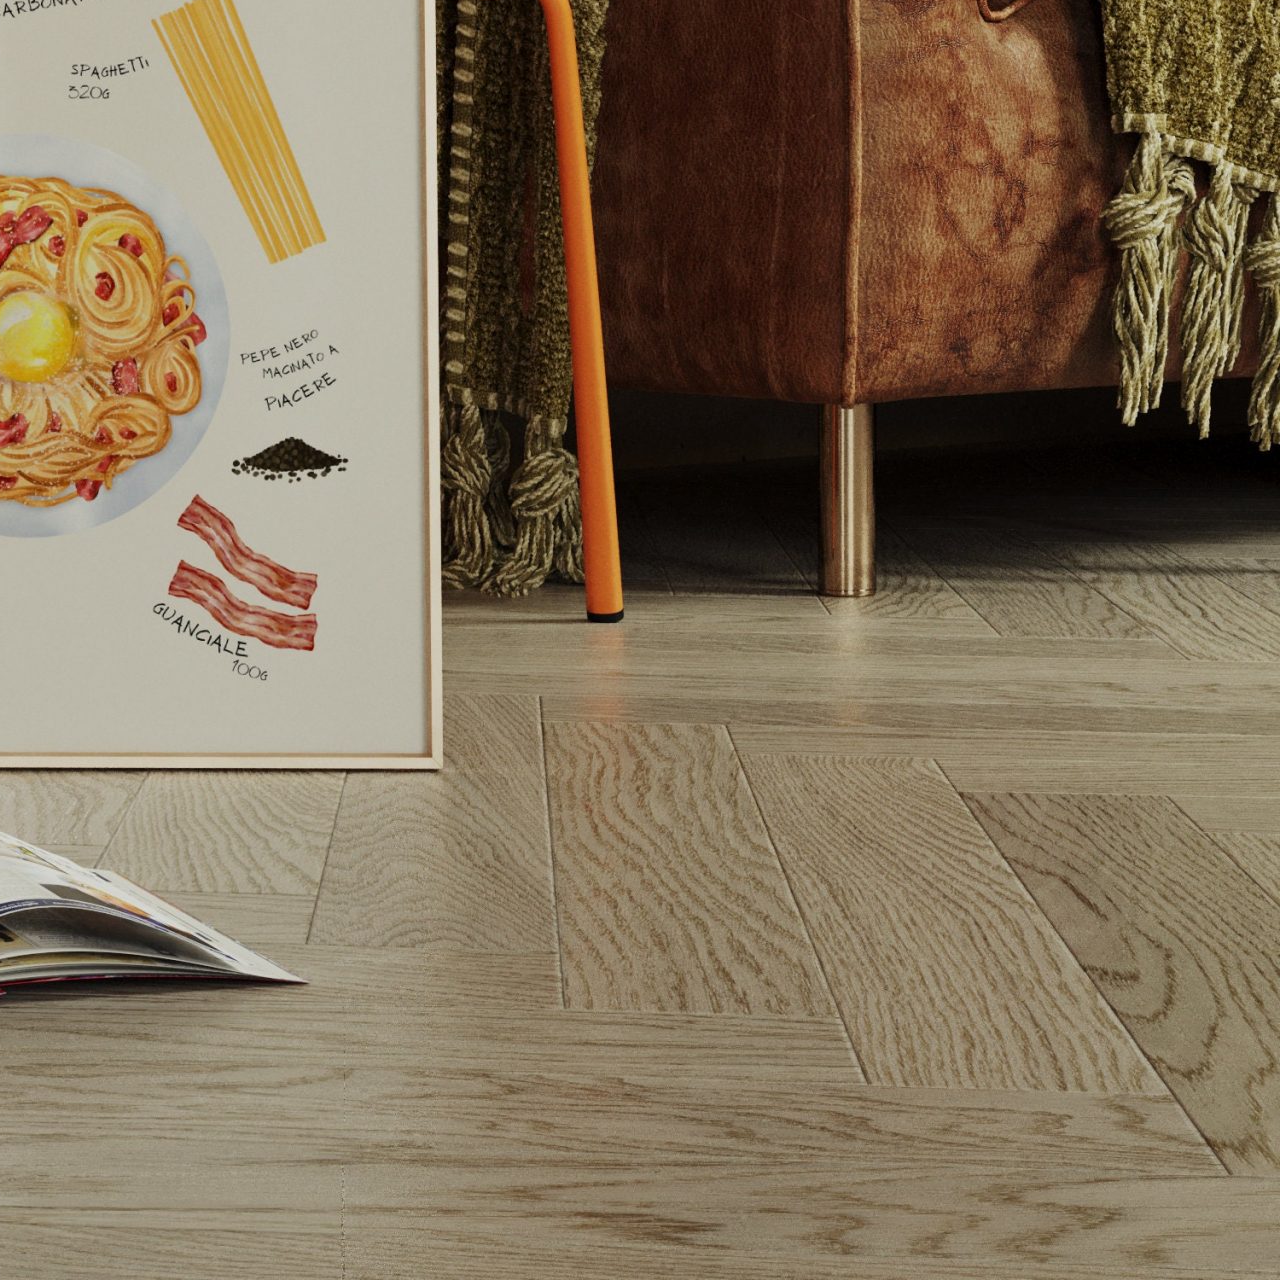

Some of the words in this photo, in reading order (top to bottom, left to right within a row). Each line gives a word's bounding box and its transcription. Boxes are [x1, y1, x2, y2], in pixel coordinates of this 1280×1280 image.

[70, 55, 150, 81] SPAGHETTI
[239, 346, 281, 365] PEPE
[283, 329, 318, 353] NERO
[262, 352, 325, 379] MACINATO
[328, 344, 340, 356] A
[264, 371, 337, 412] PIACERE
[152, 602, 249, 658] GUANCIALE
